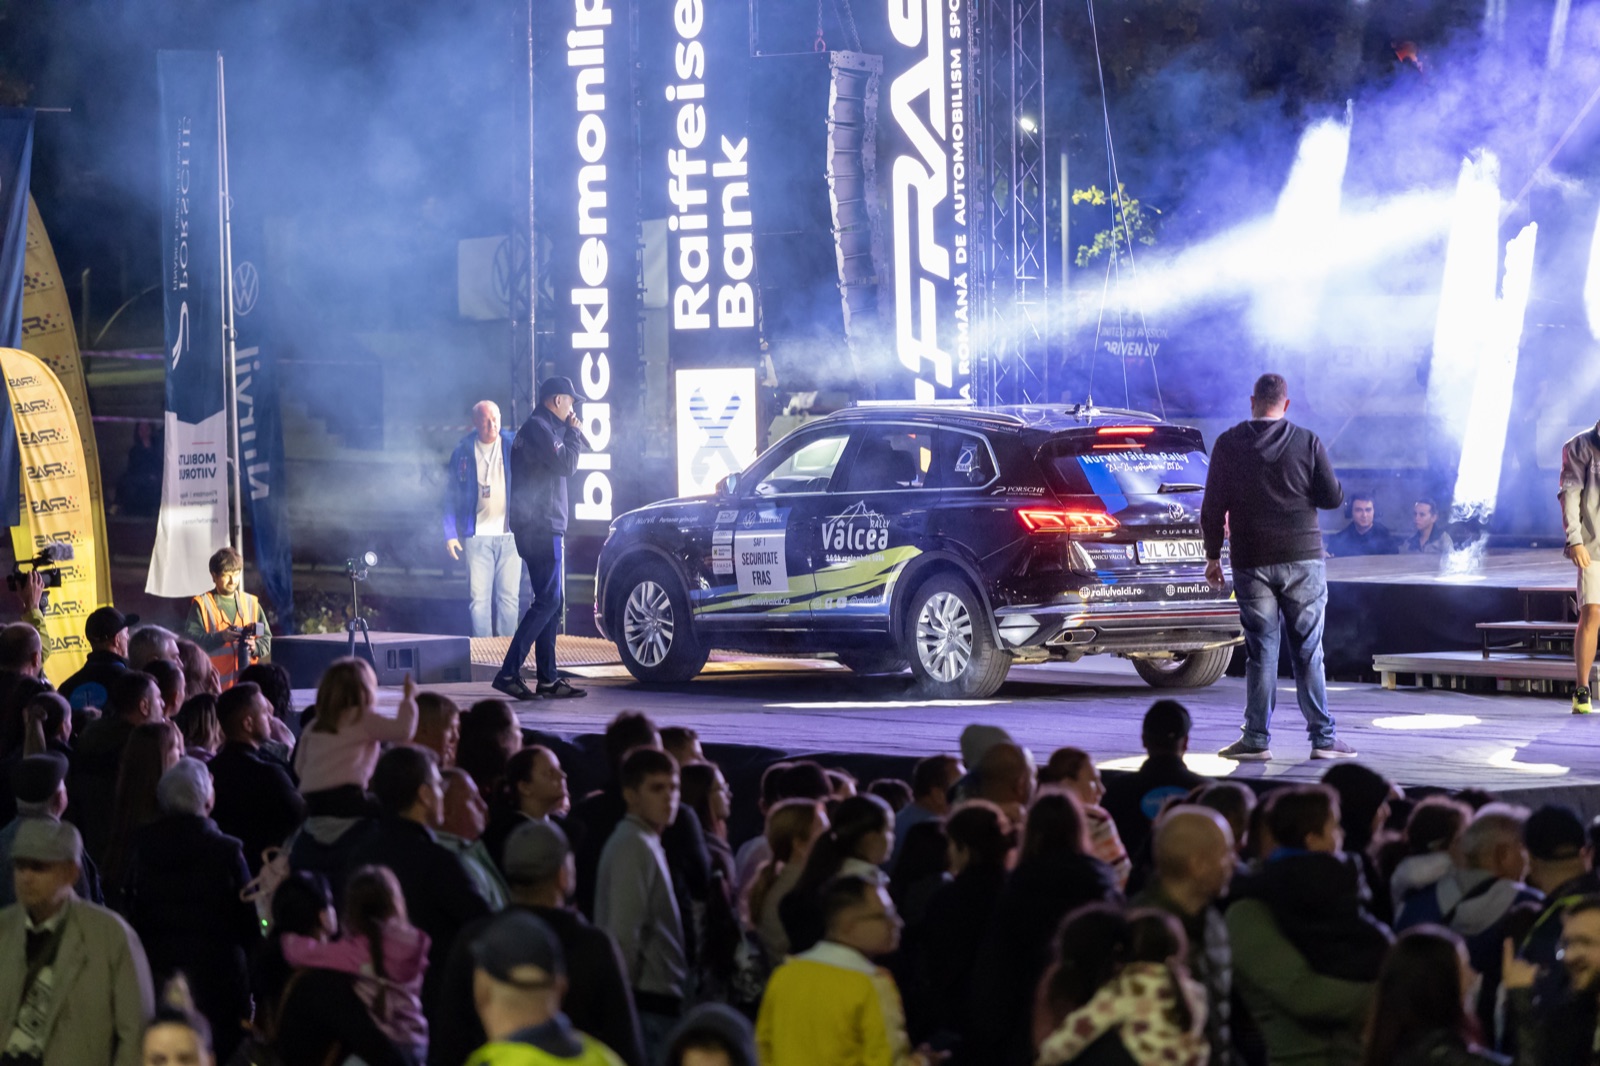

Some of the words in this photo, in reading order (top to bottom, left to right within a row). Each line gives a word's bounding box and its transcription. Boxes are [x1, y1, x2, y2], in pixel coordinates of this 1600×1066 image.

[950, 48, 967, 225] AUTOMOBILISM
[713, 134, 754, 328] Bank
[955, 234, 968, 264] DE
[1104, 341, 1144, 356] DRIVEN
[1081, 451, 1120, 464] Nurvil
[1120, 451, 1159, 462] Vâlcea
[1160, 451, 1190, 464] Rally
[821, 519, 889, 551] Vâlcea
[1144, 542, 1162, 558] VL
[1164, 541, 1177, 557] 12
[741, 552, 778, 566] SECURITATE
[752, 571, 772, 586] FRAS
[1177, 584, 1210, 594] nurvil.ro
